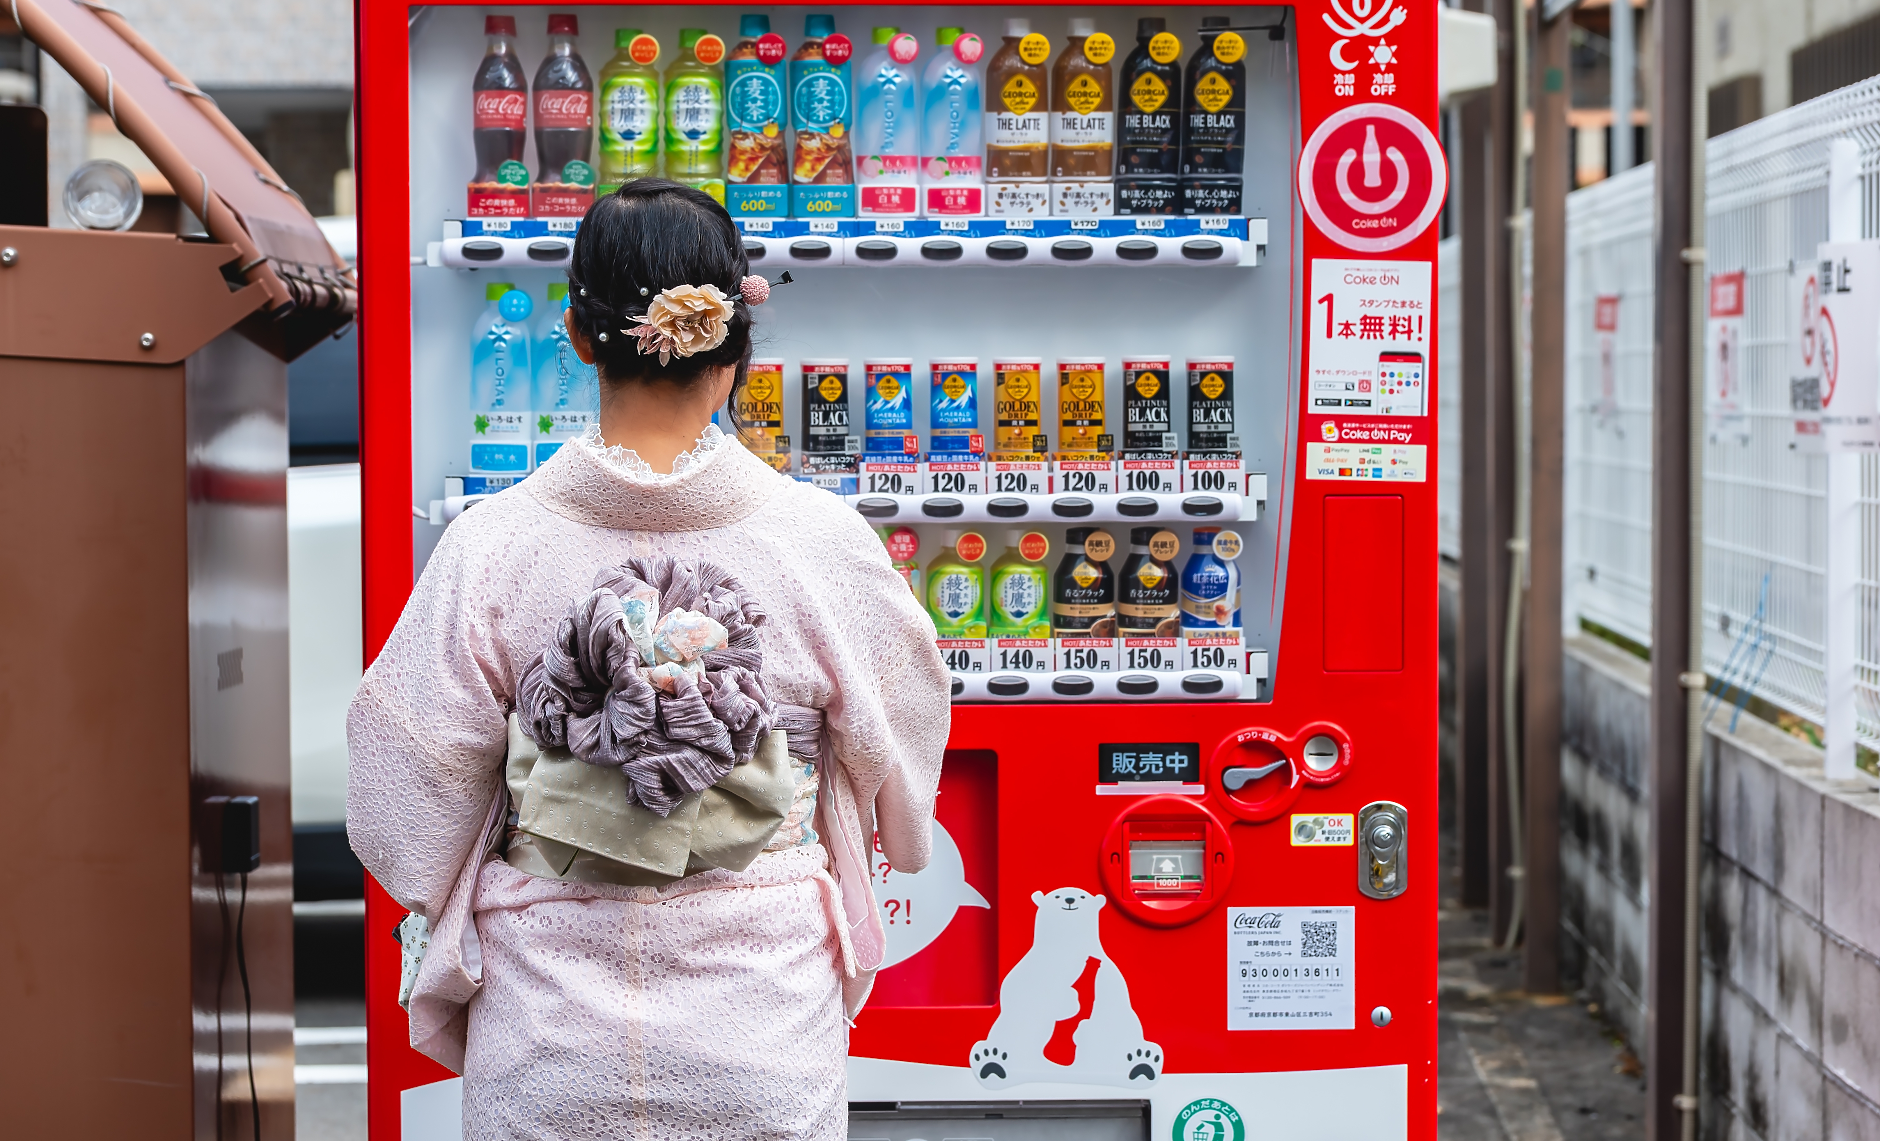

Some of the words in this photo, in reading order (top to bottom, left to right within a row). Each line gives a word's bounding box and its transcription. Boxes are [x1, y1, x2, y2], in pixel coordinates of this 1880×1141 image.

[1333, 73, 1355, 84] 冷却
[1373, 73, 1394, 84] 冷却
[1195, 88, 1230, 96] GEORGIA
[1334, 85, 1354, 96] ON
[1370, 84, 1396, 96] OFF
[744, 78, 766, 121] 麦茶
[810, 78, 832, 121] 麦茶
[997, 118, 1014, 131] THE
[1016, 118, 1041, 131] LATTE
[1062, 118, 1078, 131] THE
[1080, 118, 1105, 131] LATTE
[1125, 114, 1141, 129] THE
[1142, 114, 1171, 129] BLACK
[1190, 114, 1205, 128] THE
[1207, 114, 1235, 128] BLACK
[1352, 218, 1379, 228] Coke
[1343, 273, 1376, 285] Coke
[1380, 273, 1399, 285] ON
[1359, 299, 1423, 309] スタンプたまると
[740, 401, 781, 415] GOLDEN
[997, 401, 1038, 414] GOLDEN
[1062, 401, 1103, 414] GOLDEN
[810, 411, 849, 426] BLACK
[1128, 407, 1168, 422] BLACK
[1193, 408, 1232, 422] BLACK
[1341, 429, 1370, 439] Coke
[1371, 428, 1388, 440] ON
[1390, 430, 1412, 443] Pay
[946, 574, 963, 609] 綾鷹
[1009, 574, 1027, 609] 綾鷹
[1065, 589, 1105, 598] 香るブラック
[1130, 589, 1170, 598] 香るブラック
[1111, 752, 1189, 775] 販売中
[1328, 819, 1343, 827] OK
[1158, 879, 1177, 887] 1000
[1234, 912, 1284, 929] Coca-Cola
[1181, 1099, 1239, 1123] のんだあとは
